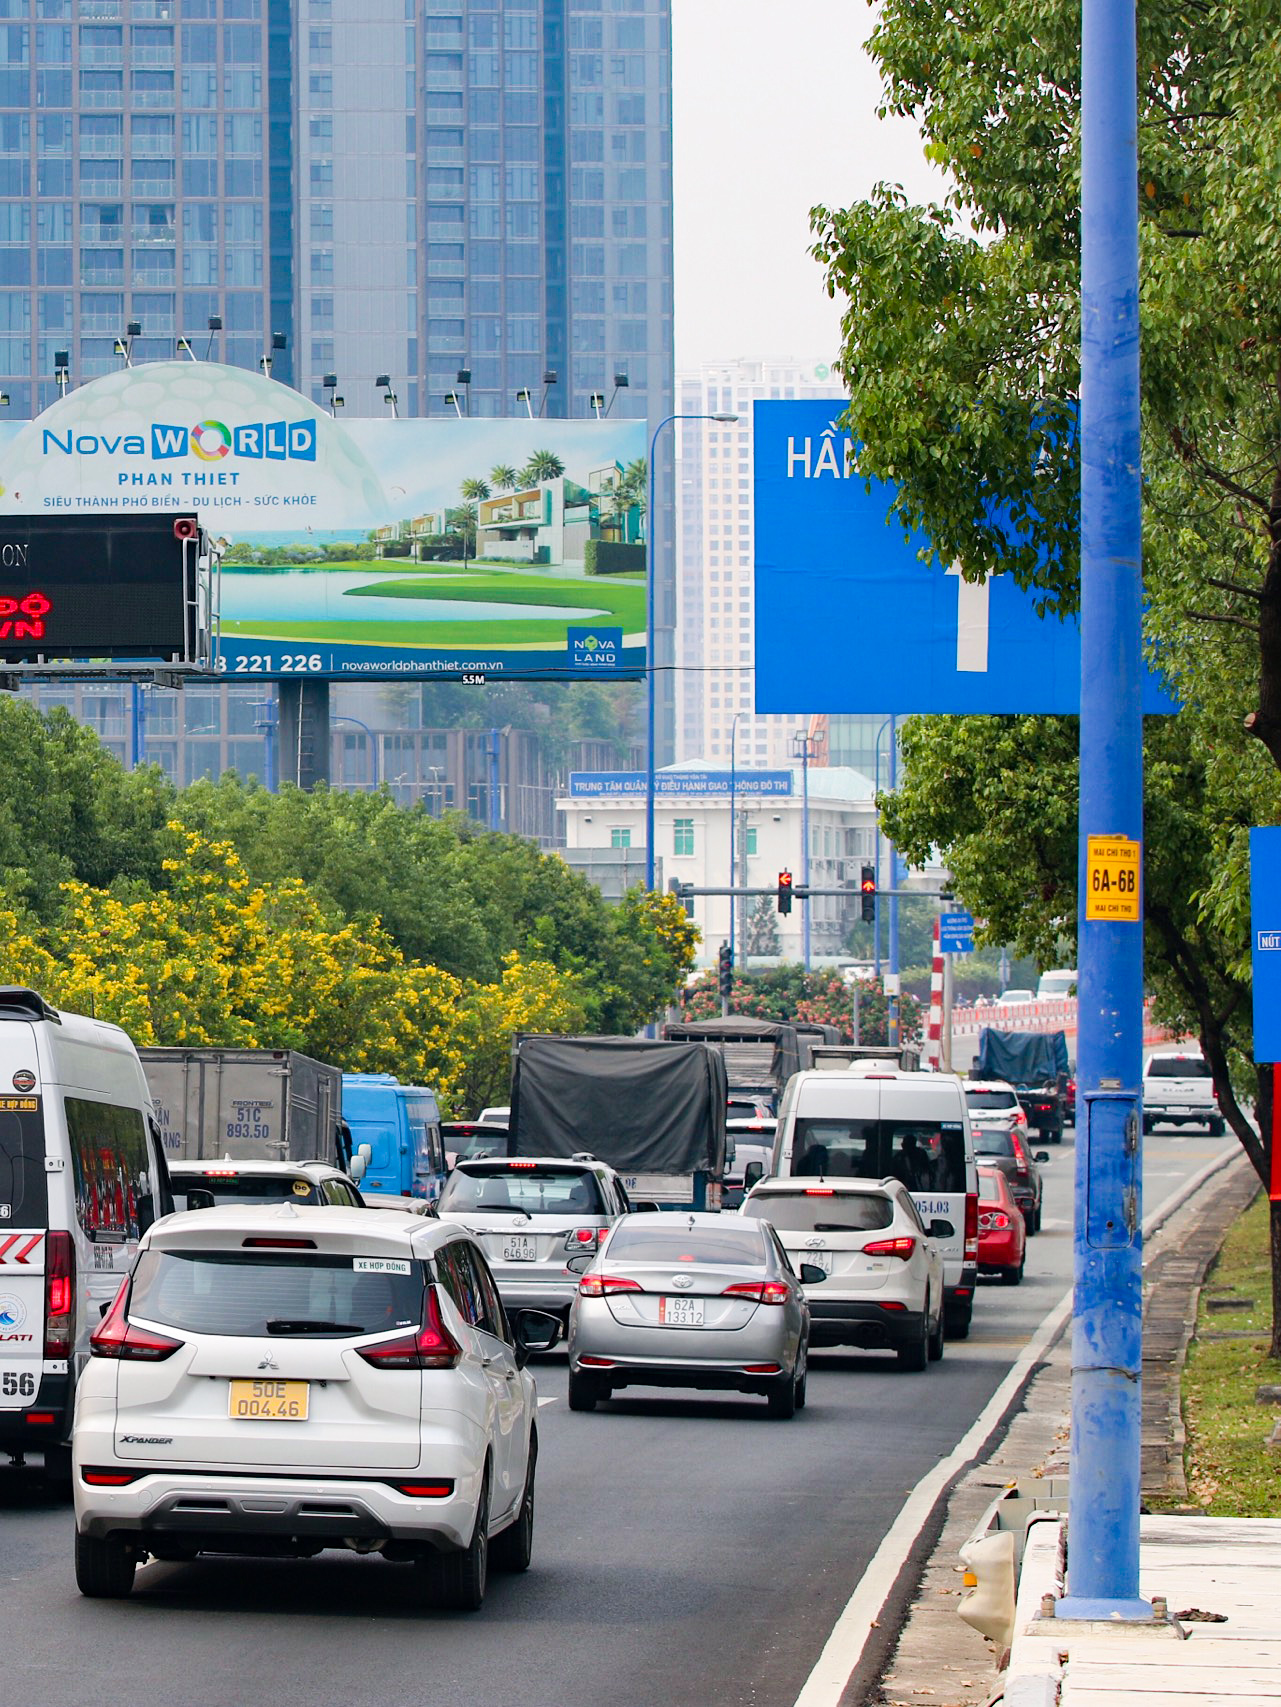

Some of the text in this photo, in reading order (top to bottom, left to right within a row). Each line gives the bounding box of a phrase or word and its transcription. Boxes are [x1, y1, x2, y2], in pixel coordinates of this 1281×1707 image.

[118, 472, 240, 486] PHAN THIET
[43, 496, 72, 507] SIÊU
[75, 495, 118, 507] THÀNH
[122, 493, 148, 507] PHỐ
[192, 496, 211, 507] DU
[213, 496, 241, 509] LỊCH
[254, 494, 279, 506] SỨC
[235, 655, 272, 672] 221
[281, 654, 322, 672] 226
[574, 653, 616, 663] LAND
[341, 660, 504, 673] novaworldphanthiet.com.vn
[574, 782, 603, 791] TRUNG
[604, 780, 622, 791] TÂM
[624, 779, 648, 791] QUẢN
[682, 780, 707, 791] HÀNH
[708, 781, 728, 791] GIAO
[729, 780, 758, 791] HÔNG
[774, 781, 788, 792] THỊ
[1093, 848, 1105, 856] MAI
[1093, 869, 1135, 892] 6A-6B
[1095, 904, 1106, 912] MAI
[1261, 933, 1281, 948] NÚT
[237, 1108, 261, 1122] 51C
[227, 1123, 269, 1138] 893.50
[511, 1238, 528, 1247] 51A
[358, 1261, 368, 1269] XE
[674, 1300, 695, 1311] 62A
[667, 1311, 703, 1324] 133.12
[252, 1381, 286, 1398] 50E
[238, 1400, 299, 1416] 004.46
[120, 1435, 173, 1445] XPANDER
